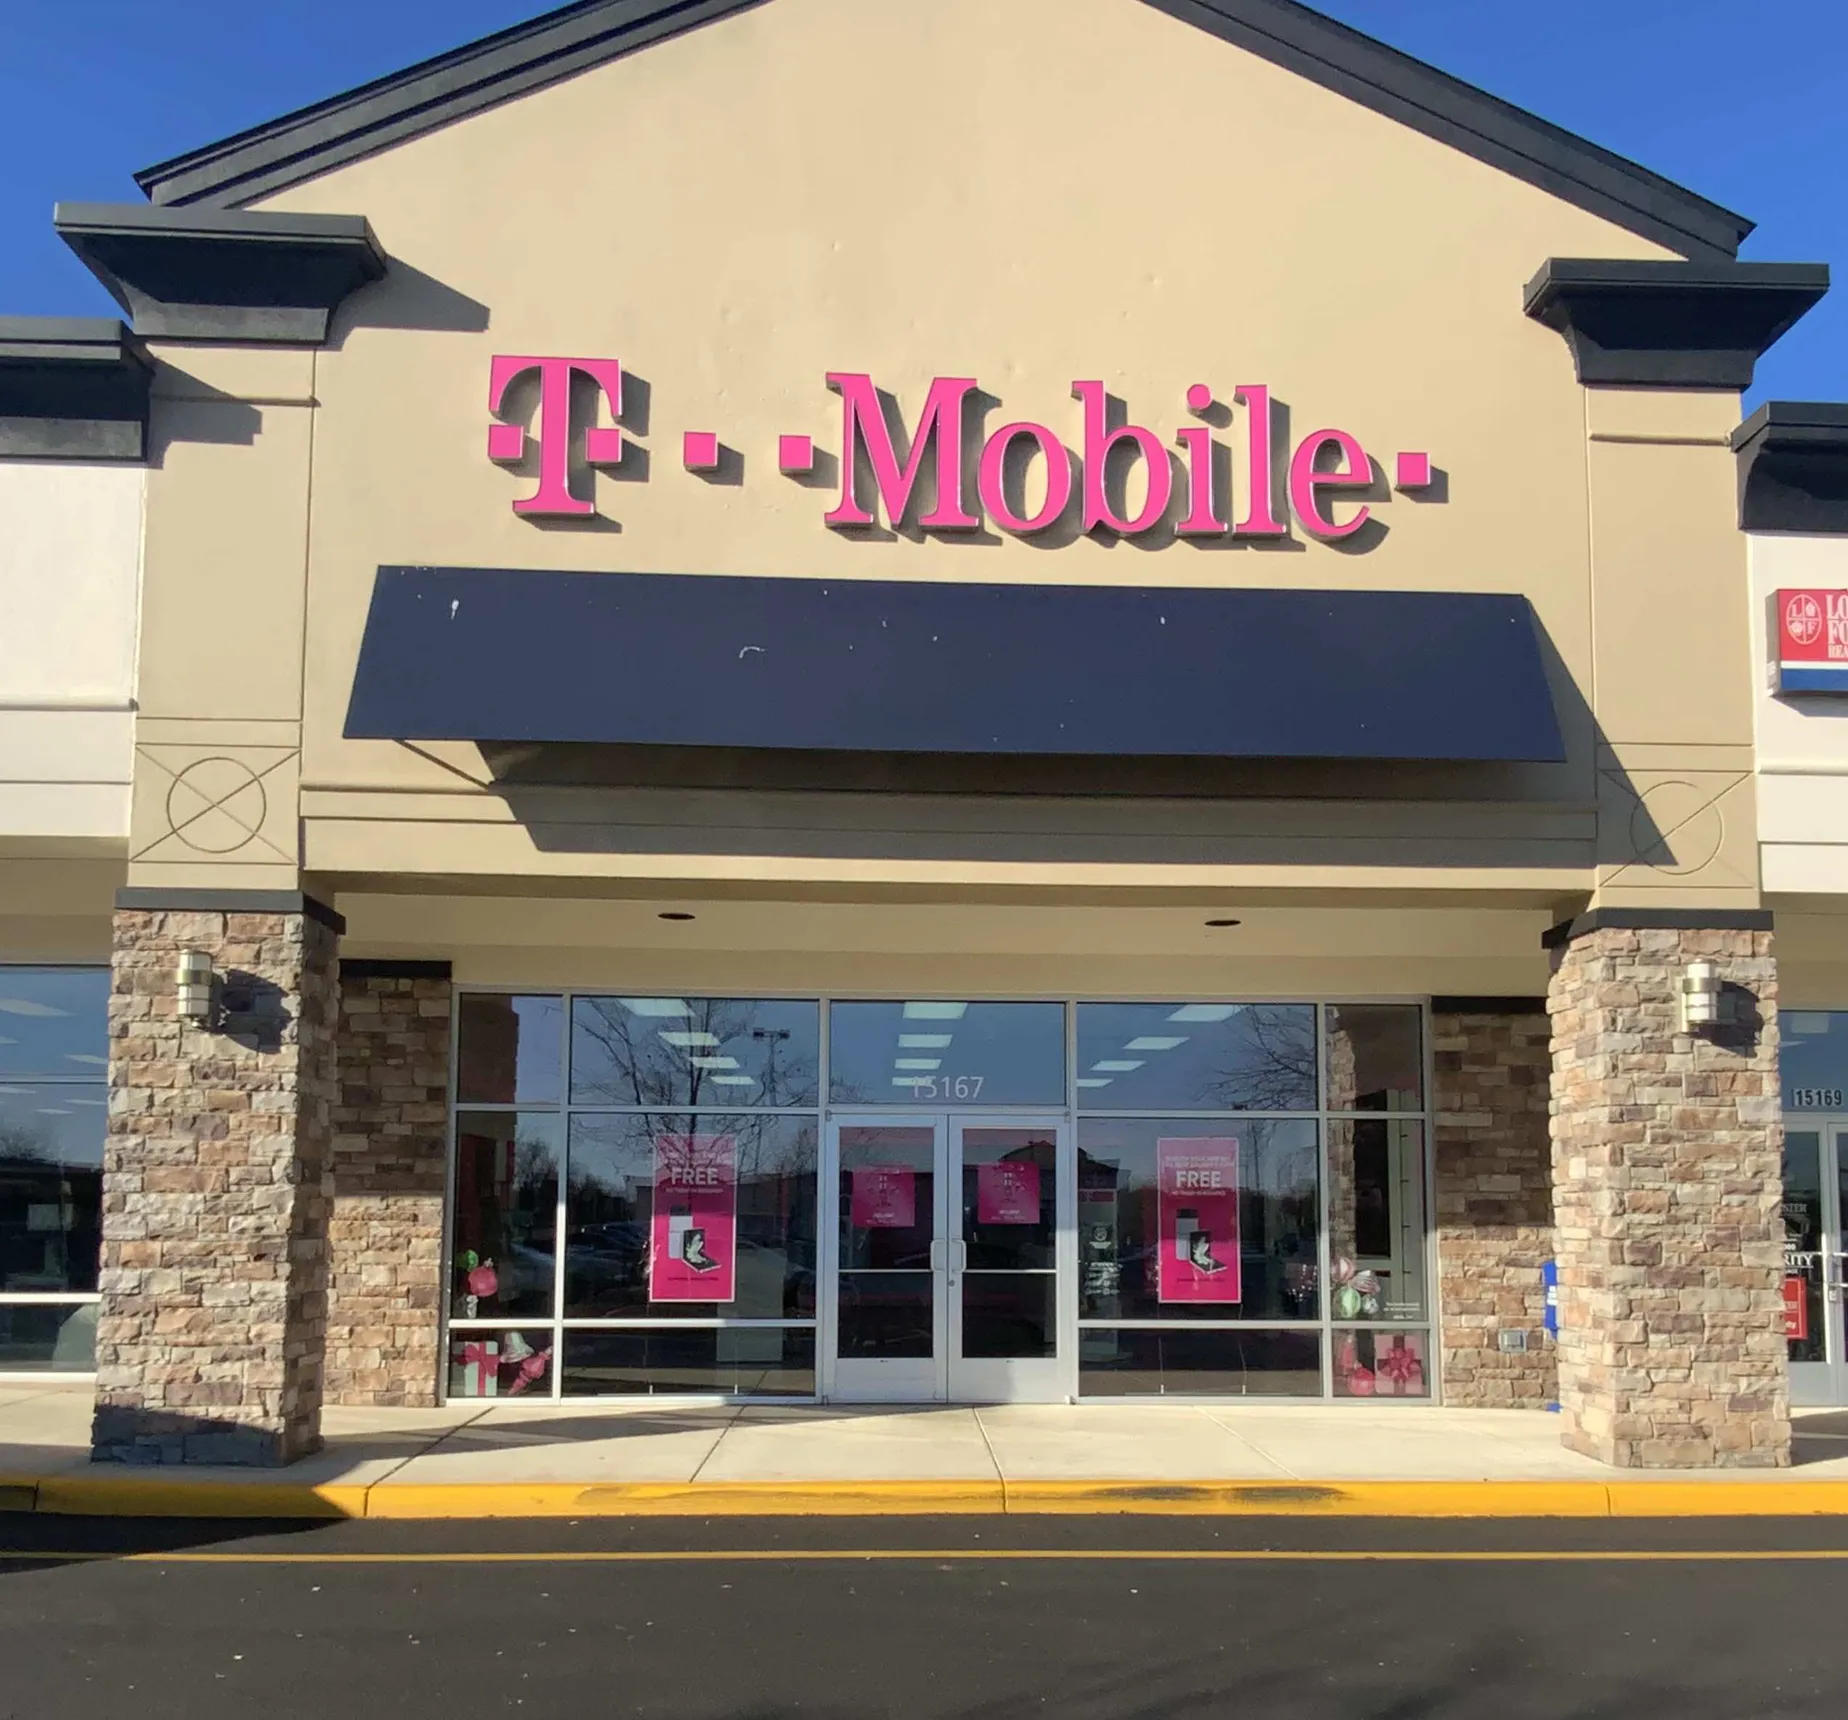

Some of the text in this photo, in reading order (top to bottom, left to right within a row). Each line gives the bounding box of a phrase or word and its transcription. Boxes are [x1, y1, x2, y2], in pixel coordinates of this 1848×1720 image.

[824, 371, 1374, 537] Mobile
[912, 1076, 985, 1098] 15167
[1796, 1089, 1842, 1106] 15169
[671, 1167, 718, 1185] FREE
[1176, 1171, 1222, 1188] FREE
